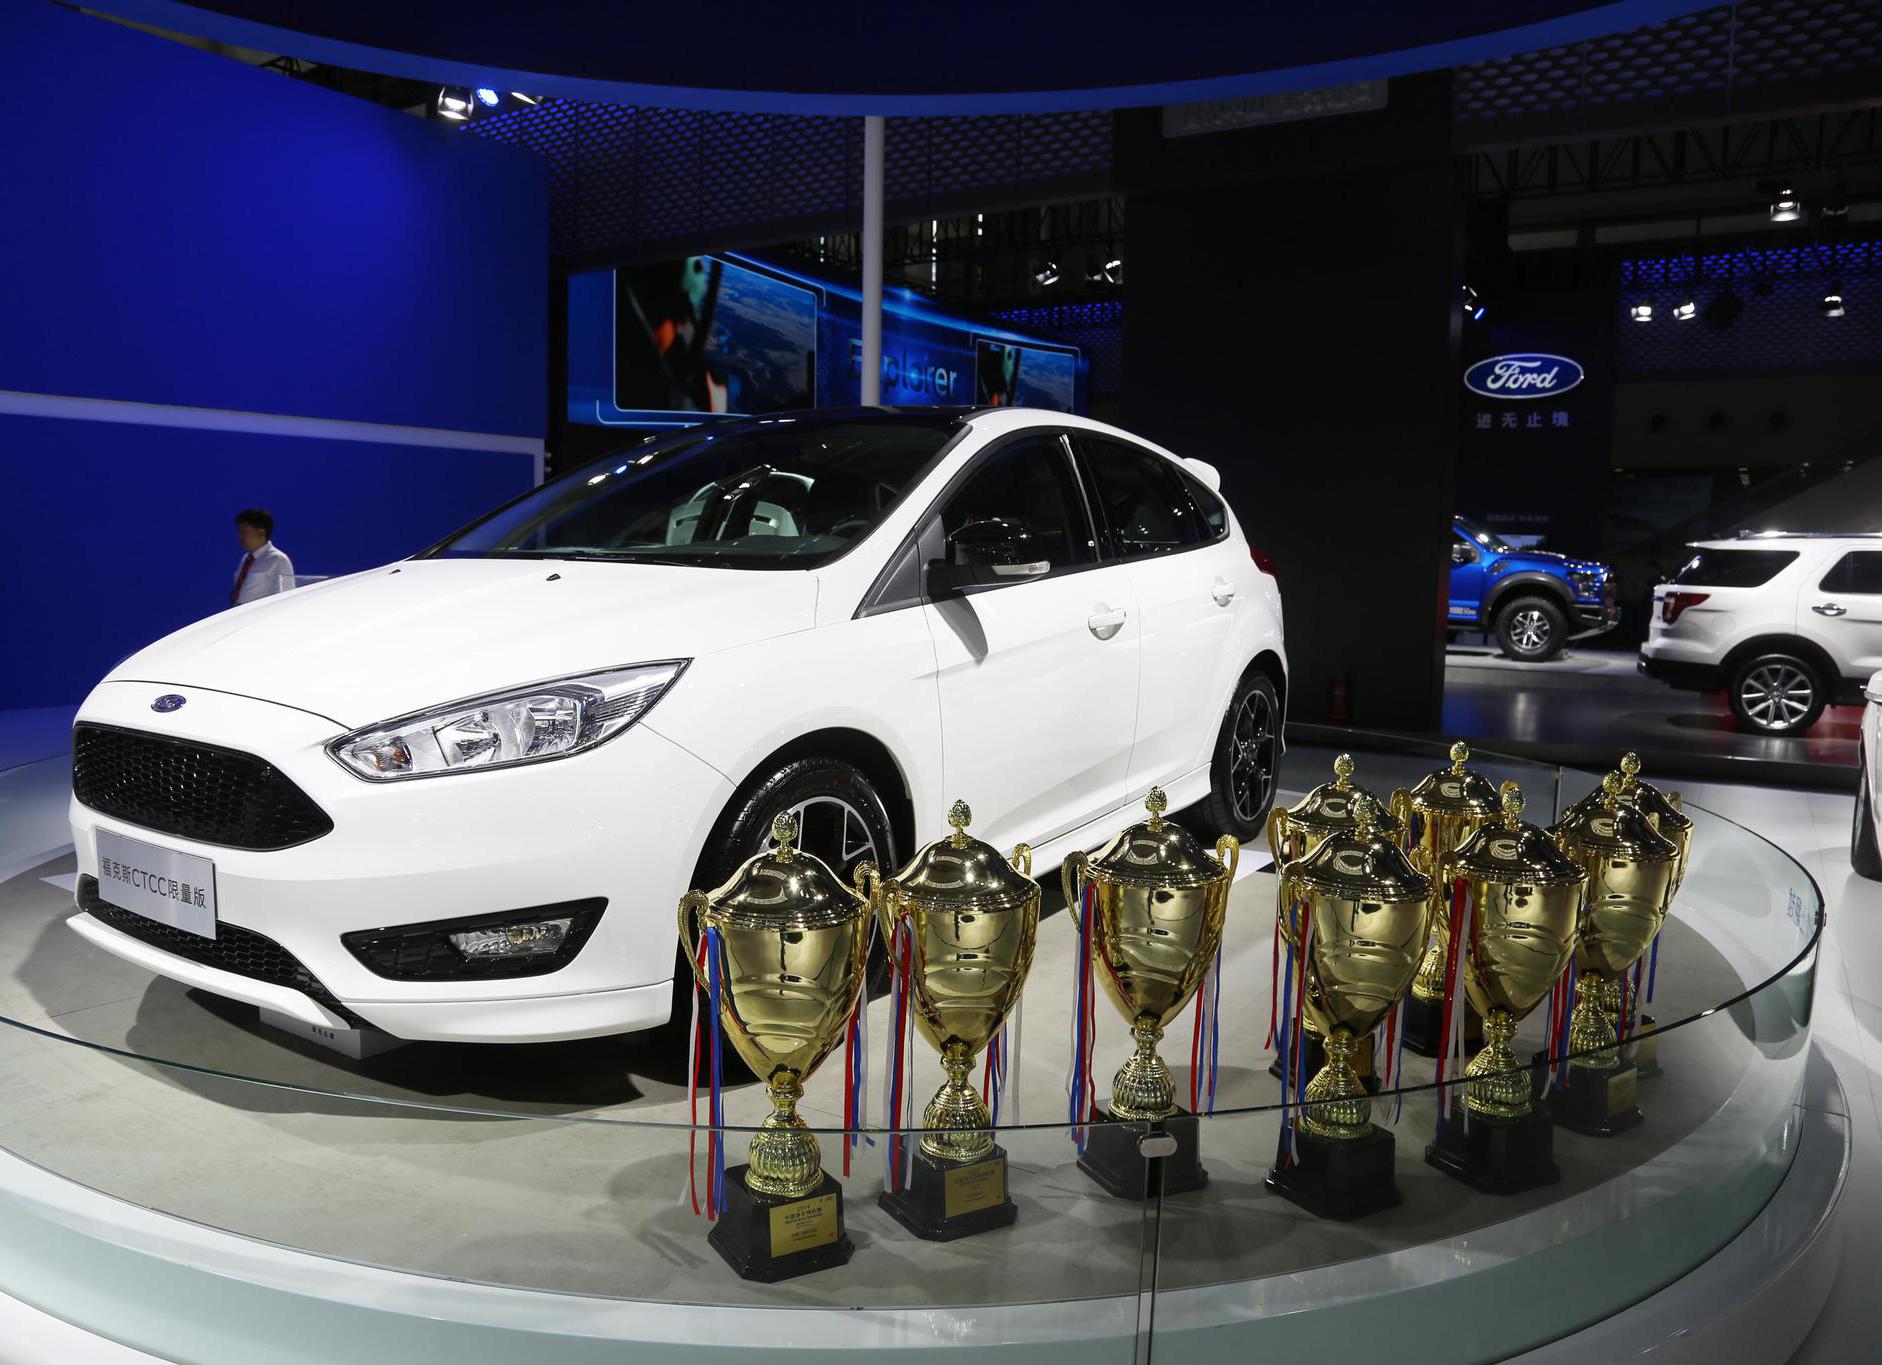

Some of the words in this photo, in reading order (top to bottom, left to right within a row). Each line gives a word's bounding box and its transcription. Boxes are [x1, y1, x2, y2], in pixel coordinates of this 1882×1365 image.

[848, 338, 958, 397] Eplorer
[1486, 360, 1559, 389] Ford
[1476, 411, 1569, 428] 进无止境
[102, 856, 206, 909] 福克斯CTCC限量版
